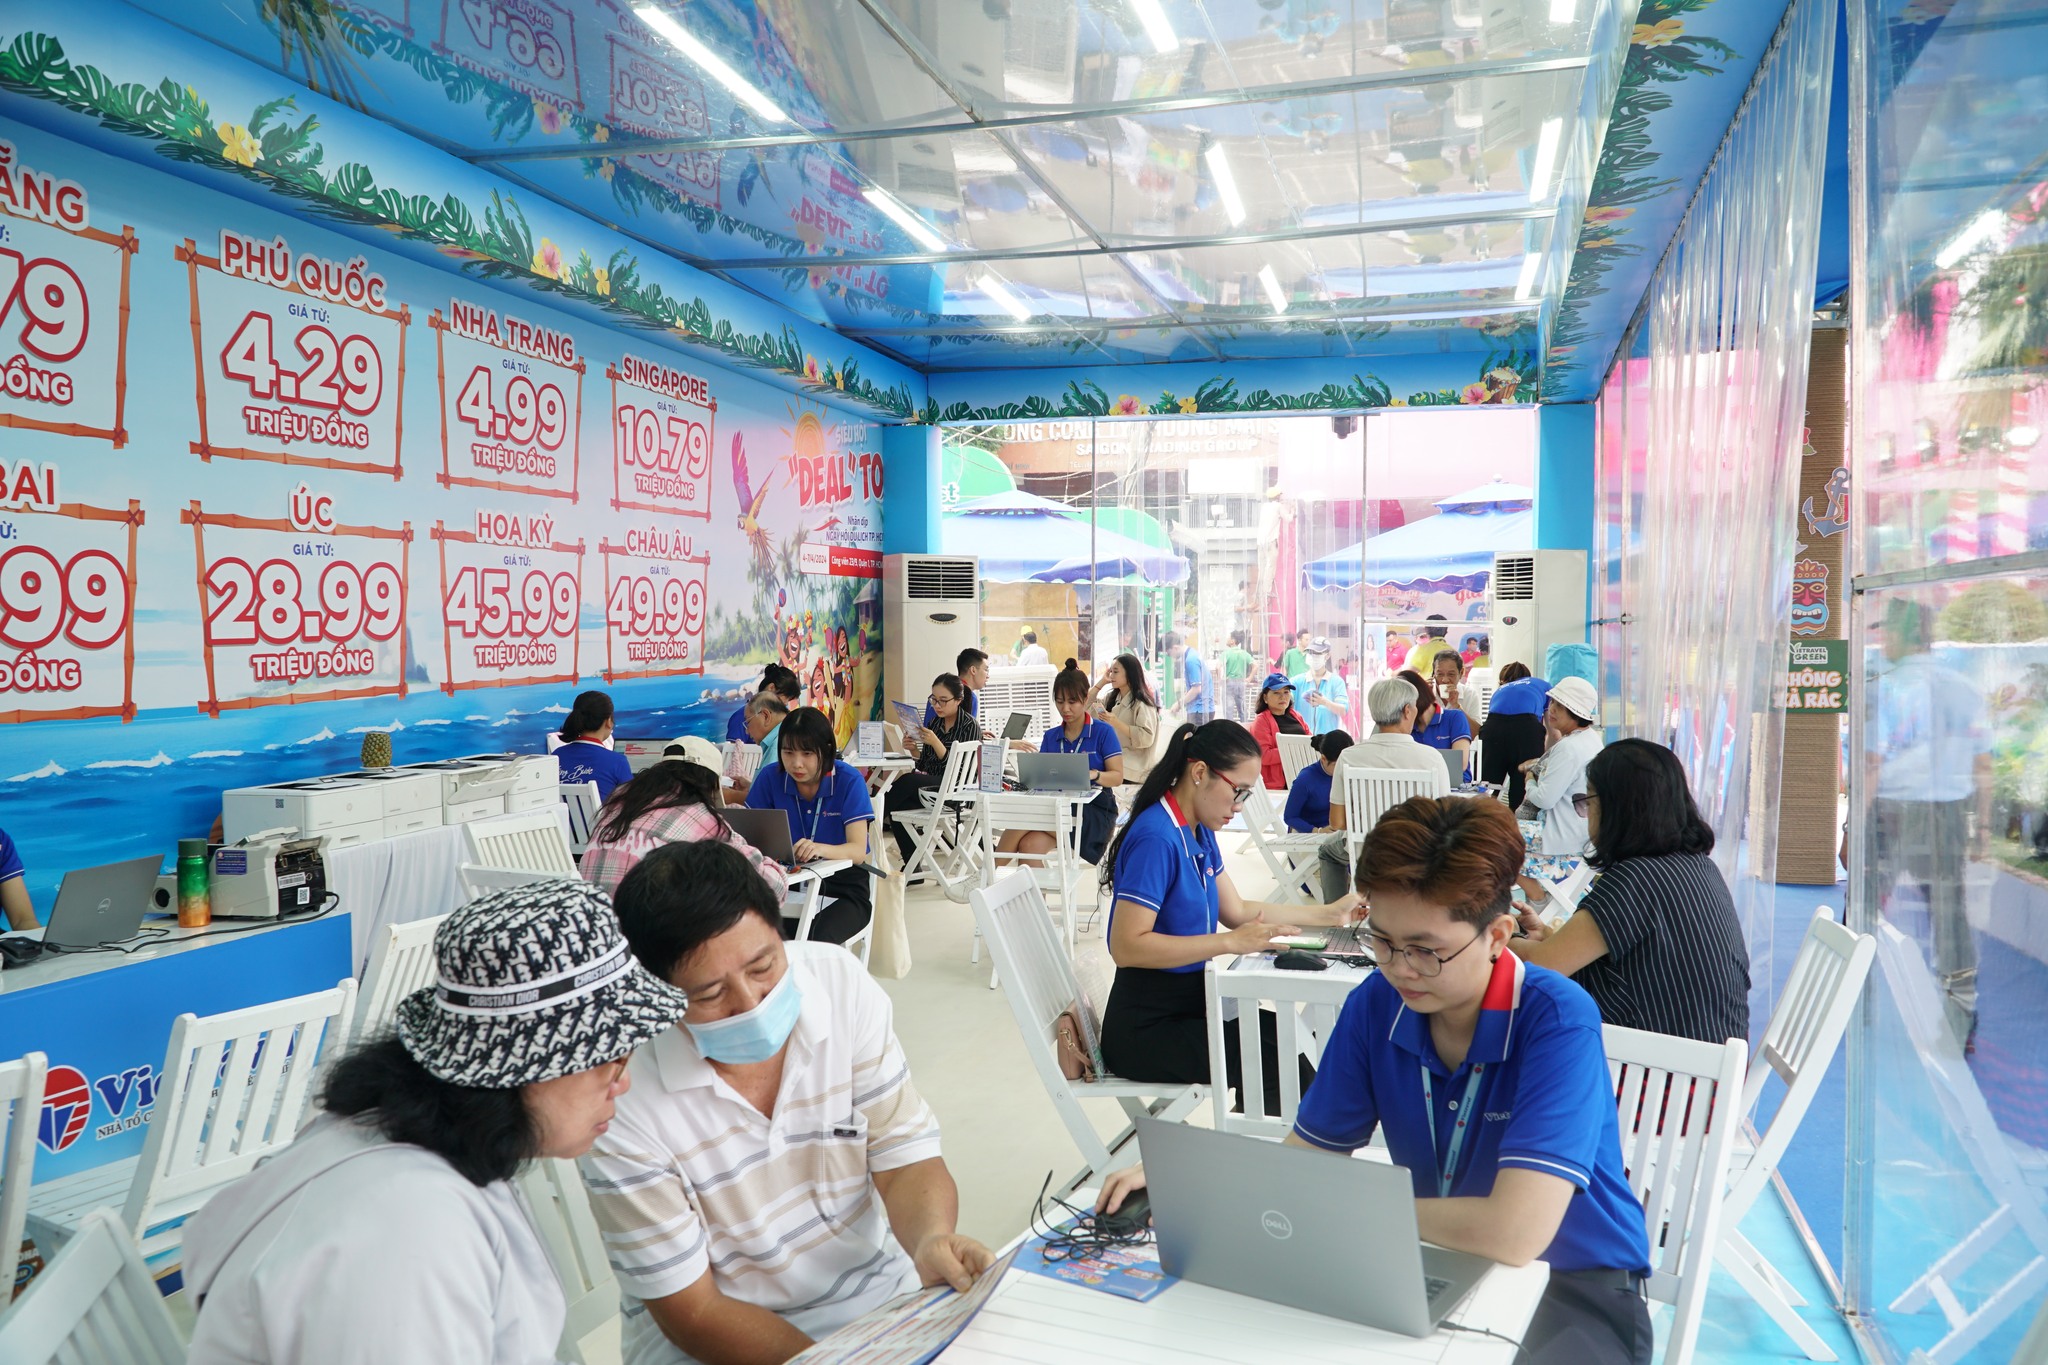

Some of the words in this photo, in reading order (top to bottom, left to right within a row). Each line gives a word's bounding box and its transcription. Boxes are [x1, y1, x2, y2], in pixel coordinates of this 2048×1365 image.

[223, 234, 291, 283] PHÚ
[299, 254, 385, 309] QUỐC
[288, 303, 308, 320] GIÁ
[311, 307, 331, 324] TỪ:
[452, 301, 500, 342] NHA
[506, 319, 574, 363] TRANG
[221, 310, 383, 416] 4.29
[502, 358, 516, 372] GIÁ
[516, 361, 531, 375] TỪ:
[622, 356, 709, 403] SINGAPORE
[243, 406, 308, 443] TRIỆU
[311, 410, 369, 449] ĐỒNG
[456, 365, 567, 451] 4.99
[472, 443, 515, 473] TRIỆU
[516, 446, 555, 477] ĐỒNG
[618, 404, 709, 479] 10.79
[635, 473, 665, 499] TRIỆU
[665, 474, 695, 500] ĐỒNG
[859, 451, 884, 500] TO
[292, 485, 334, 530] ÚC
[477, 511, 524, 543] HOA
[528, 512, 555, 545] KỲ
[292, 543, 313, 557] GIÁ
[315, 542, 334, 558] TỪ:
[503, 555, 517, 567] GIÁ
[517, 556, 532, 567] TỪ:
[626, 526, 668, 555] CHÂU
[671, 529, 692, 557] ÂU
[0, 544, 130, 650] 99
[204, 556, 402, 645] 28.99
[443, 566, 579, 638] 45.99
[606, 575, 705, 636] 49.99
[249, 646, 314, 684] TRIỆU
[316, 642, 374, 675] ĐỒNG
[474, 640, 516, 671] TRIỆU
[517, 636, 557, 663] ĐỒNG
[628, 638, 659, 665] TRIỆU
[659, 636, 688, 660] ĐỒNG
[1804, 687, 1842, 709] RÁC
[468, 993, 516, 1008] CHRISTIAN
[516, 989, 540, 1005] DIOR
[97, 1118, 123, 1139] NHÀ
[125, 1109, 141, 1129] TỔ
